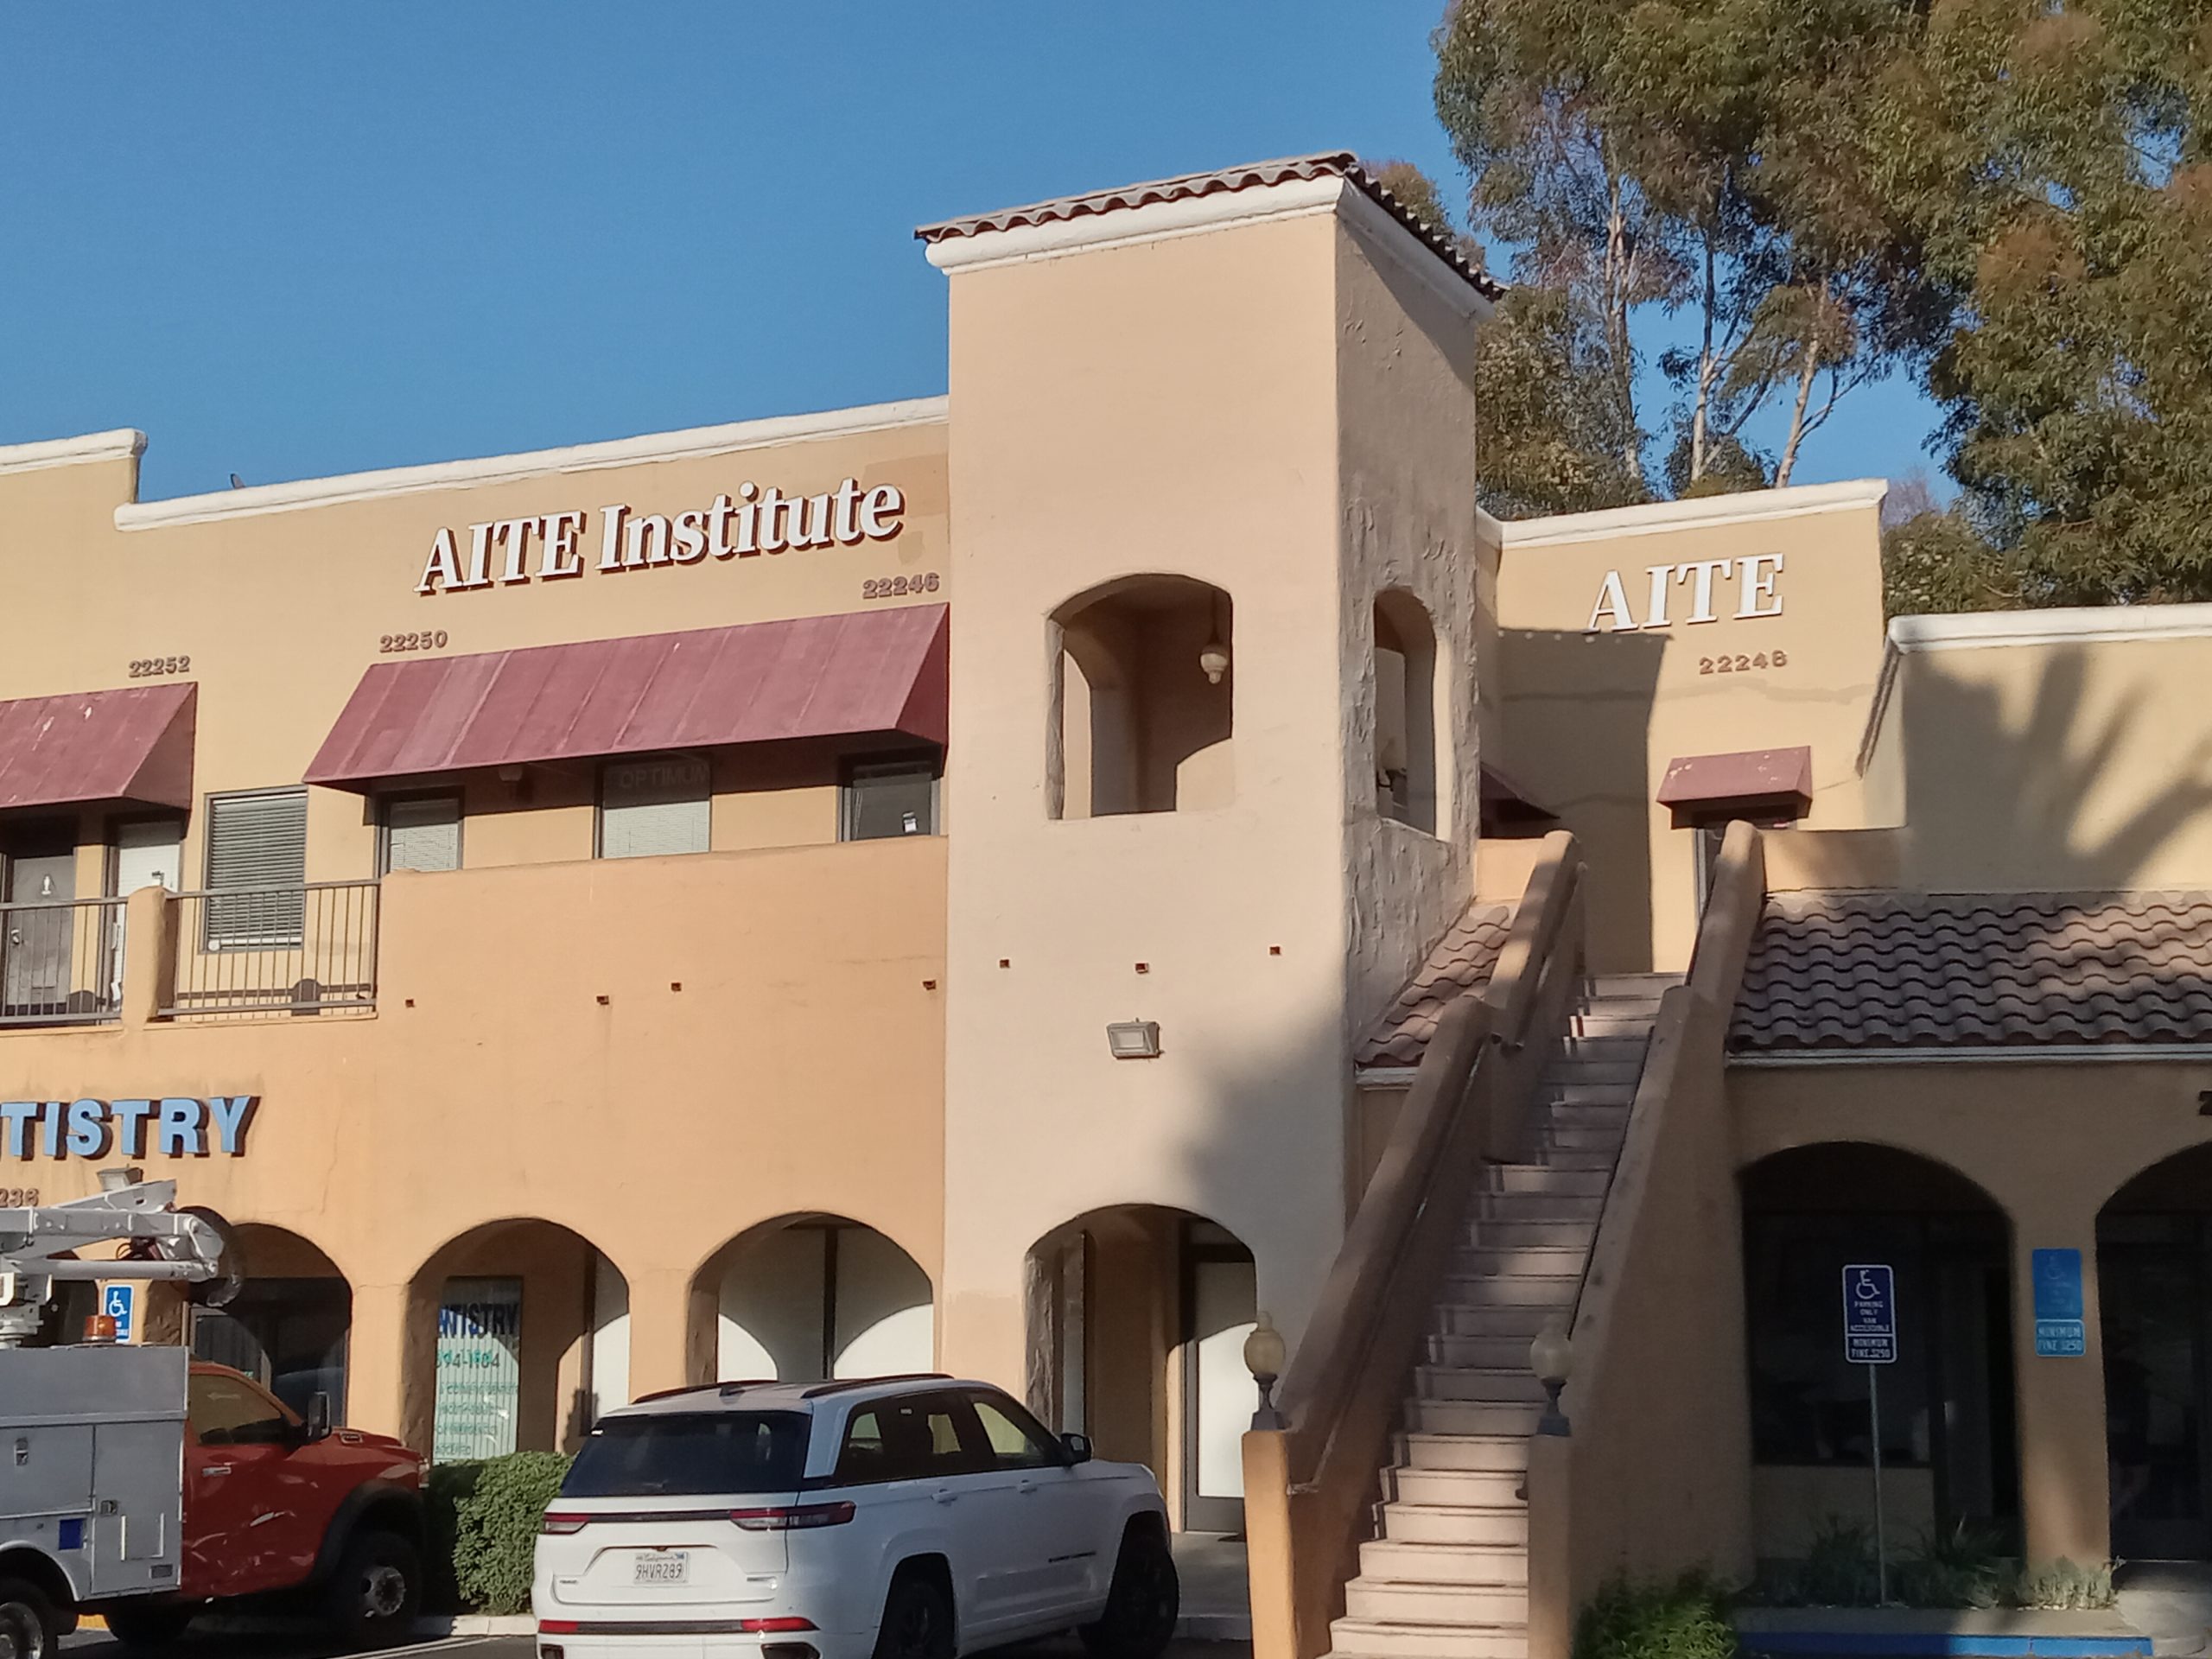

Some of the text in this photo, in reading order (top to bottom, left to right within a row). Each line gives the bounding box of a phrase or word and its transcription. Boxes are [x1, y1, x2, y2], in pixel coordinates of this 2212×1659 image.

[414, 477, 906, 596] AITE Institute
[863, 572, 940, 599] 22246
[1581, 552, 1784, 634] AITE
[379, 629, 448, 653] 22250
[129, 655, 190, 678] 22252
[0, 1095, 259, 1160] TISTRY
